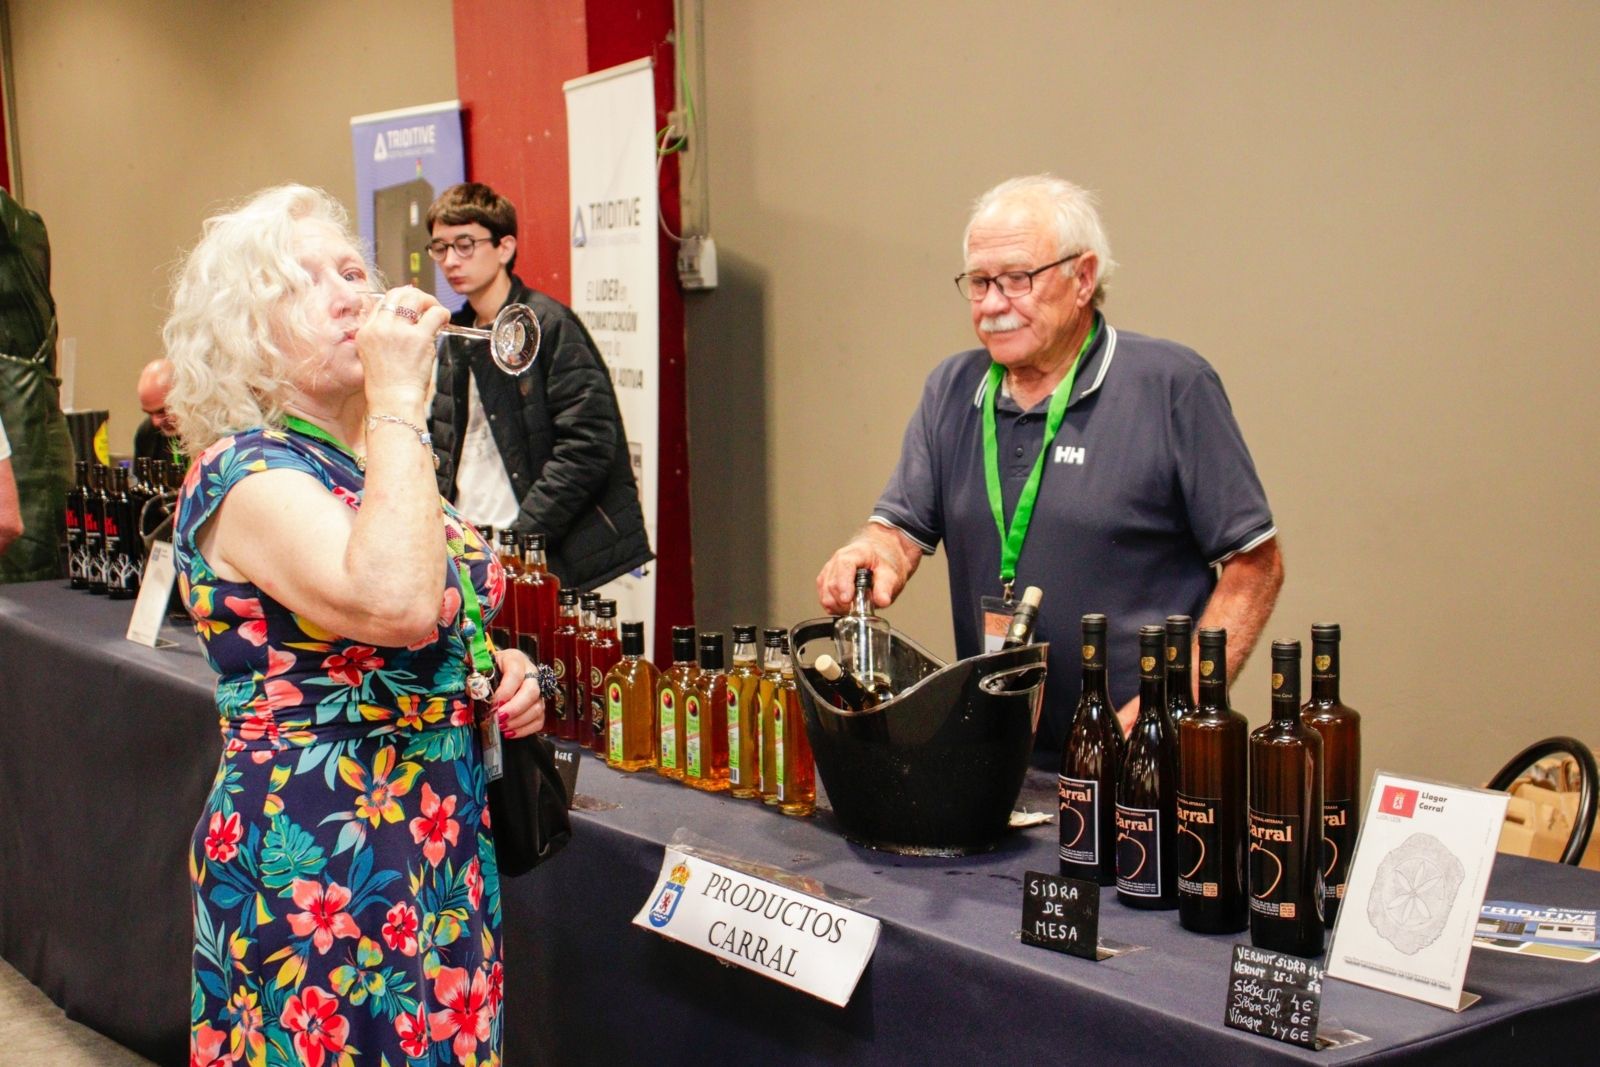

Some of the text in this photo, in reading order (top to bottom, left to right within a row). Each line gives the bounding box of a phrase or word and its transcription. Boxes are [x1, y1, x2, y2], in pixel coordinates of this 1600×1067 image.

[589, 197, 640, 230] TRIDITIVE
[1054, 445, 1085, 465] HH
[1421, 792, 1447, 803] Llagar
[1177, 806, 1215, 825] arral
[1249, 821, 1293, 842] arral
[701, 872, 847, 944] PRODUCTOS
[1042, 901, 1064, 917] DE
[1035, 920, 1078, 942] MESA
[708, 920, 800, 977] CARRAL
[1237, 946, 1276, 965] VERMUT
